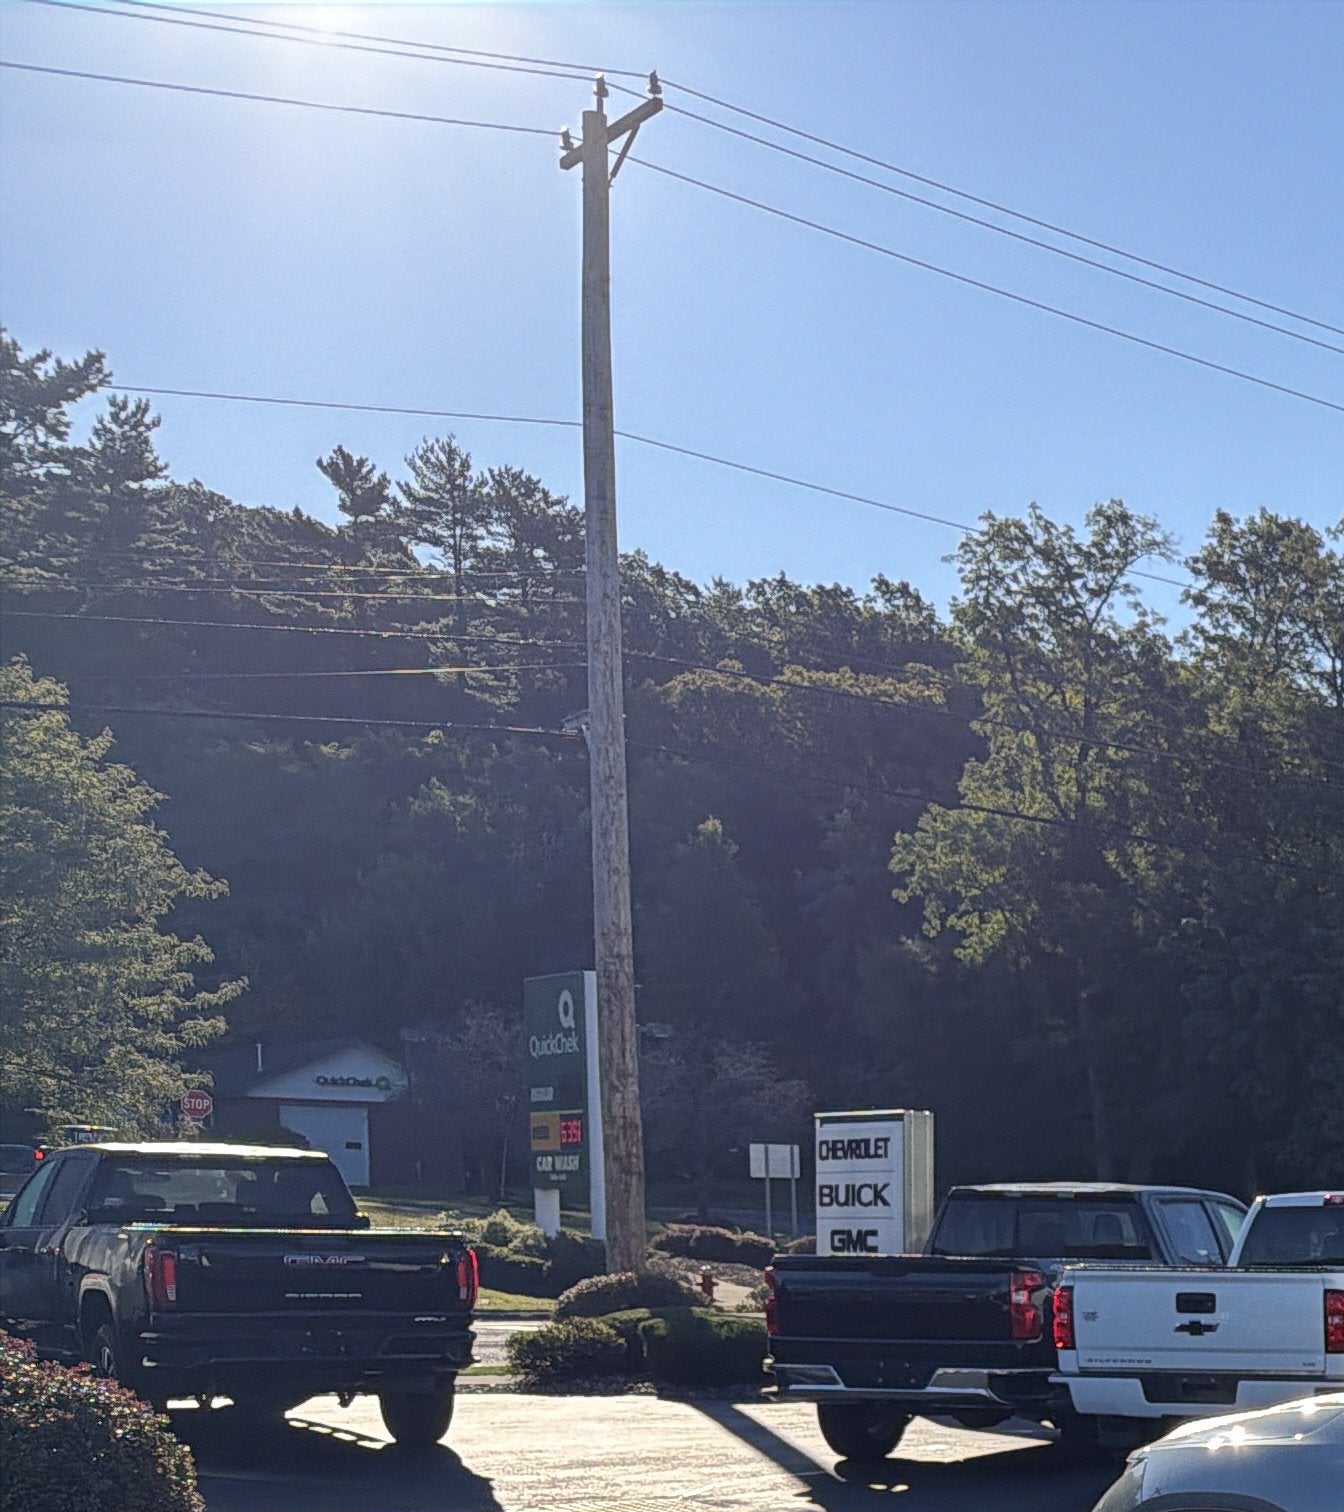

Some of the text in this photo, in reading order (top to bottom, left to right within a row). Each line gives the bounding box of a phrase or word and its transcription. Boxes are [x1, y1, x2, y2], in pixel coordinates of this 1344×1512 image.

[558, 989, 576, 1029] Q
[529, 1031, 580, 1059] QuickChek
[183, 1098, 210, 1110] STOP
[818, 1136, 891, 1161] CHEVROLET
[536, 1154, 580, 1172] CAR WASH
[818, 1182, 891, 1208] BUICK
[830, 1229, 879, 1253] GMC
